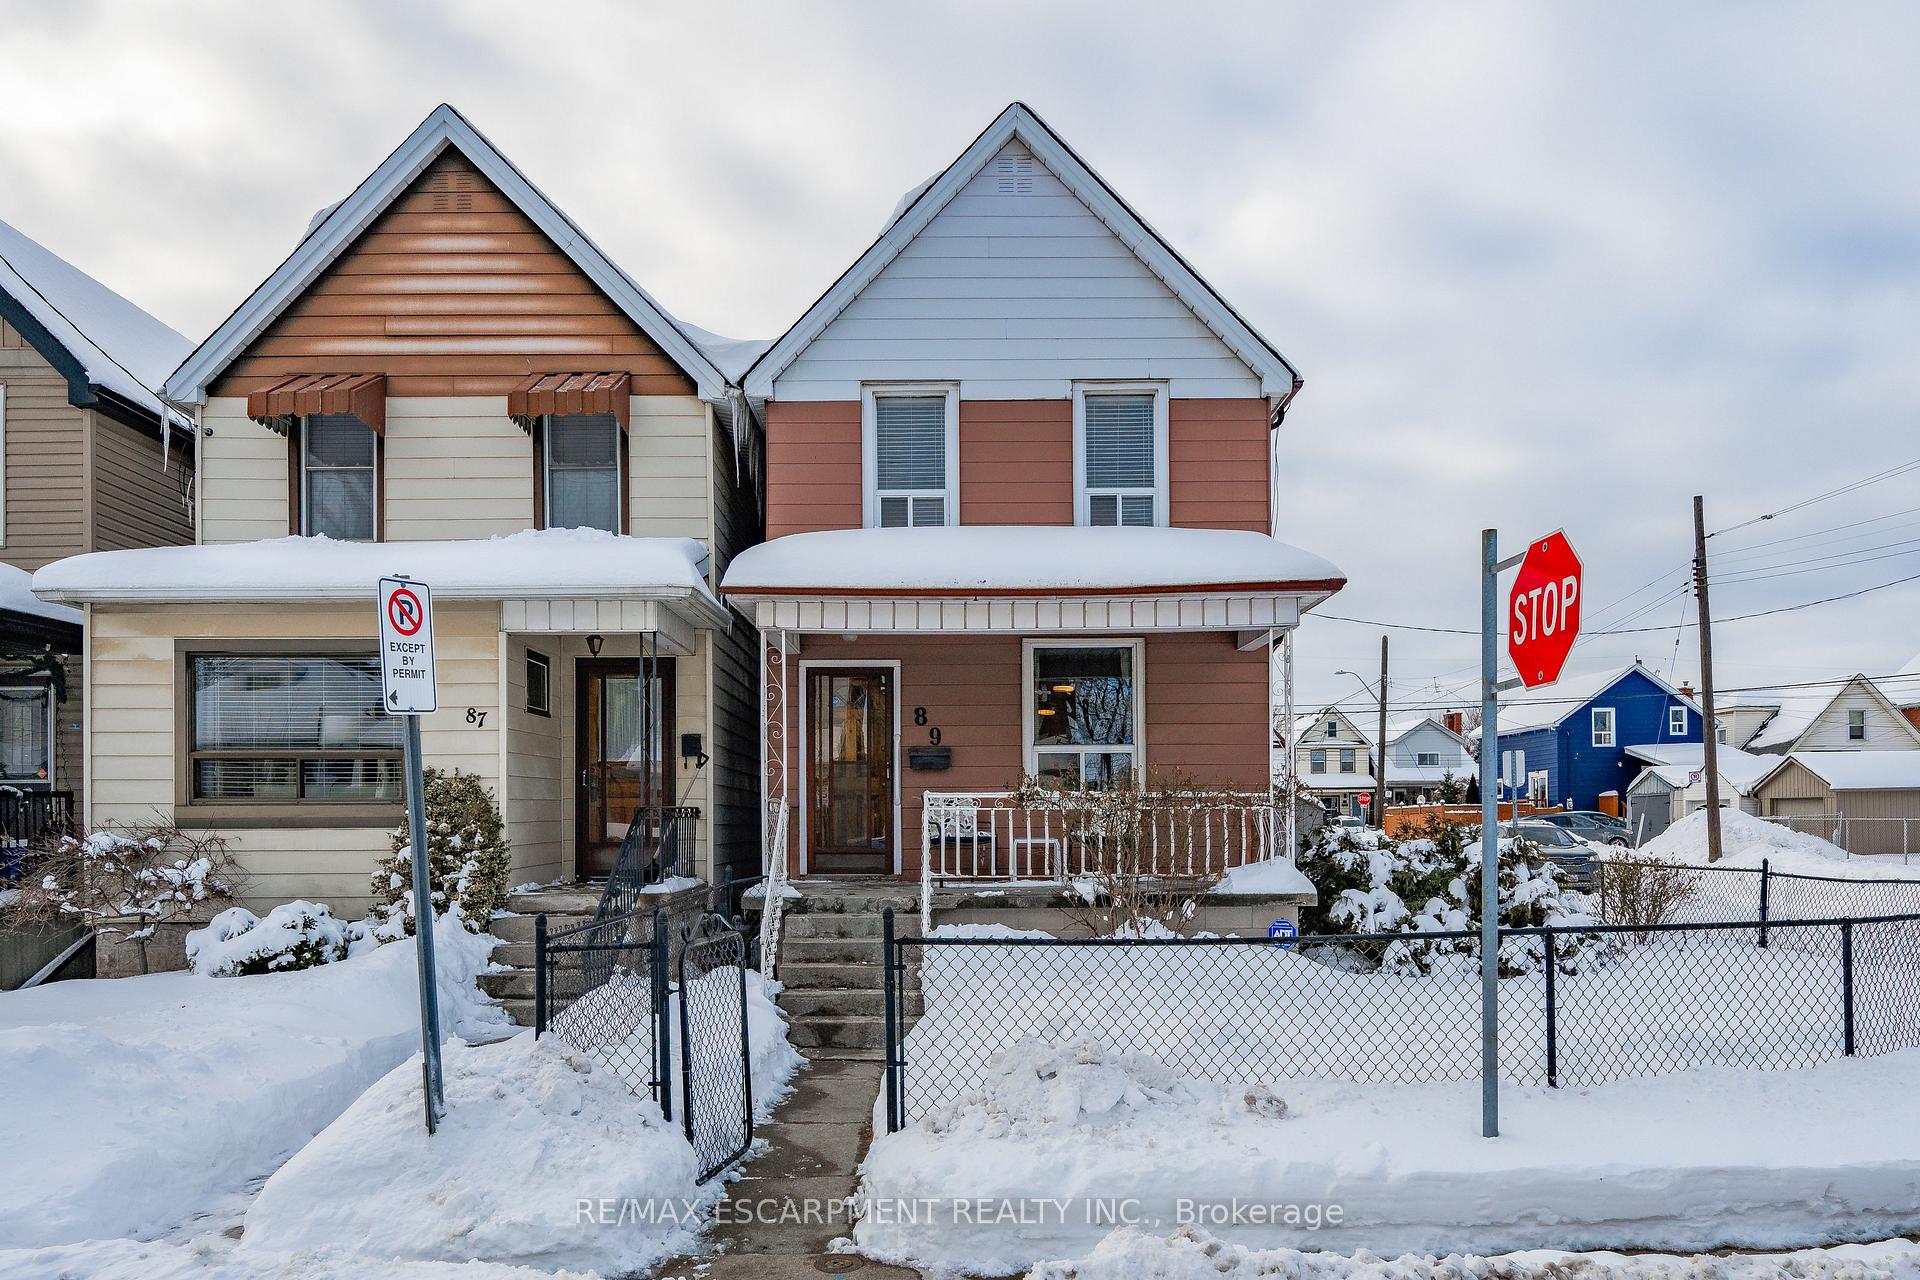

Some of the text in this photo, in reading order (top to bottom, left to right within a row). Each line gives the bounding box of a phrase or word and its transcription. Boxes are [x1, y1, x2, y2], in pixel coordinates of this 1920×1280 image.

[399, 599, 414, 625] P
[1513, 575, 1578, 645] STOP
[390, 642, 426, 654] EXCEPT
[402, 656, 415, 666] BY
[392, 668, 426, 679] PERMIT
[466, 707, 488, 728] 87
[1273, 929, 1293, 938] ADT
